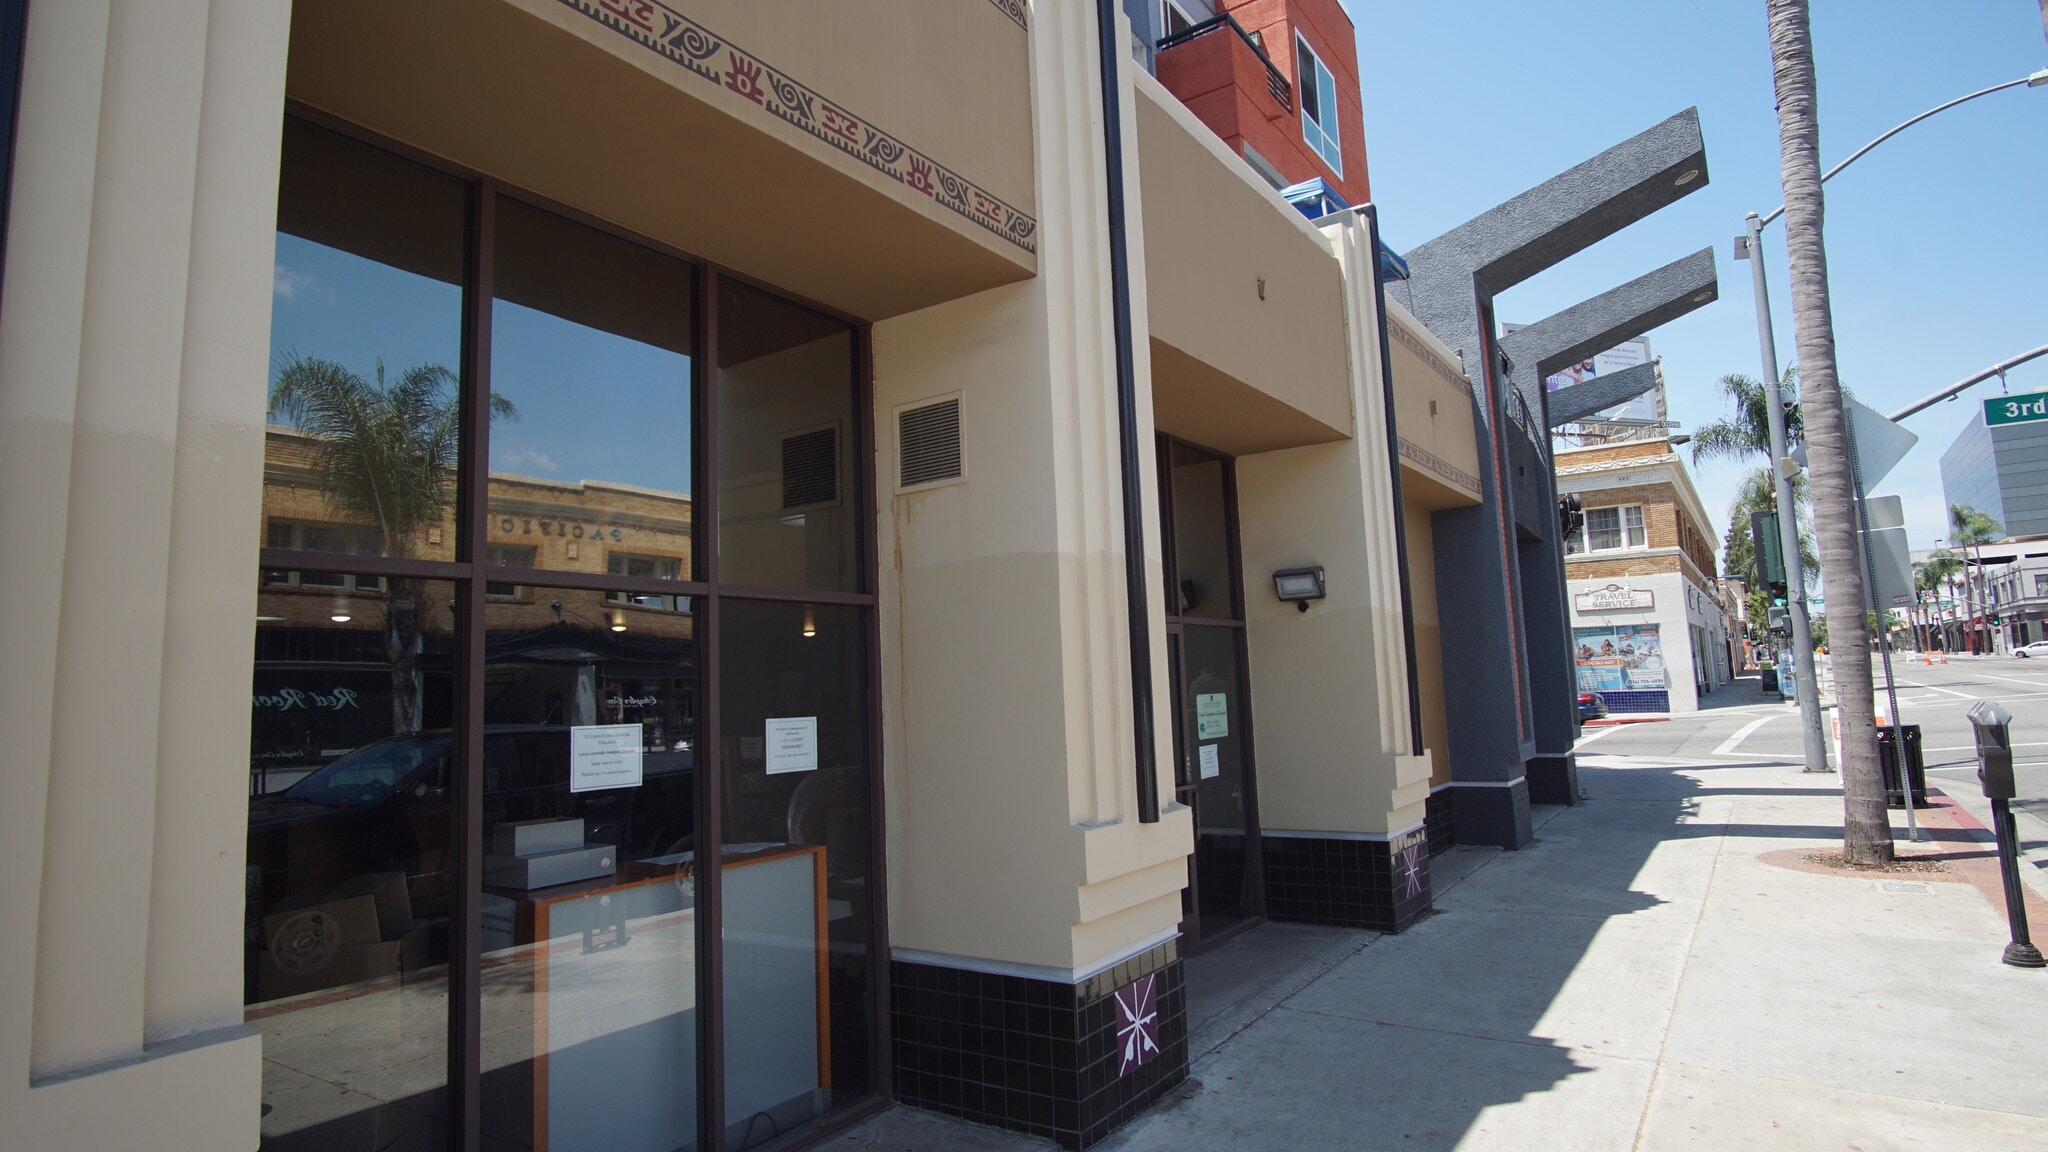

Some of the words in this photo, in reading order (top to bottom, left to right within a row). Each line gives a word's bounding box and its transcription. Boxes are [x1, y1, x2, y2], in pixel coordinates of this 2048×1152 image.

[1546, 374, 1568, 384] ntro
[2005, 396, 2046, 417] 3rd
[1593, 592, 1634, 600] TRAVEL
[1592, 600, 1637, 608] SERVICE
